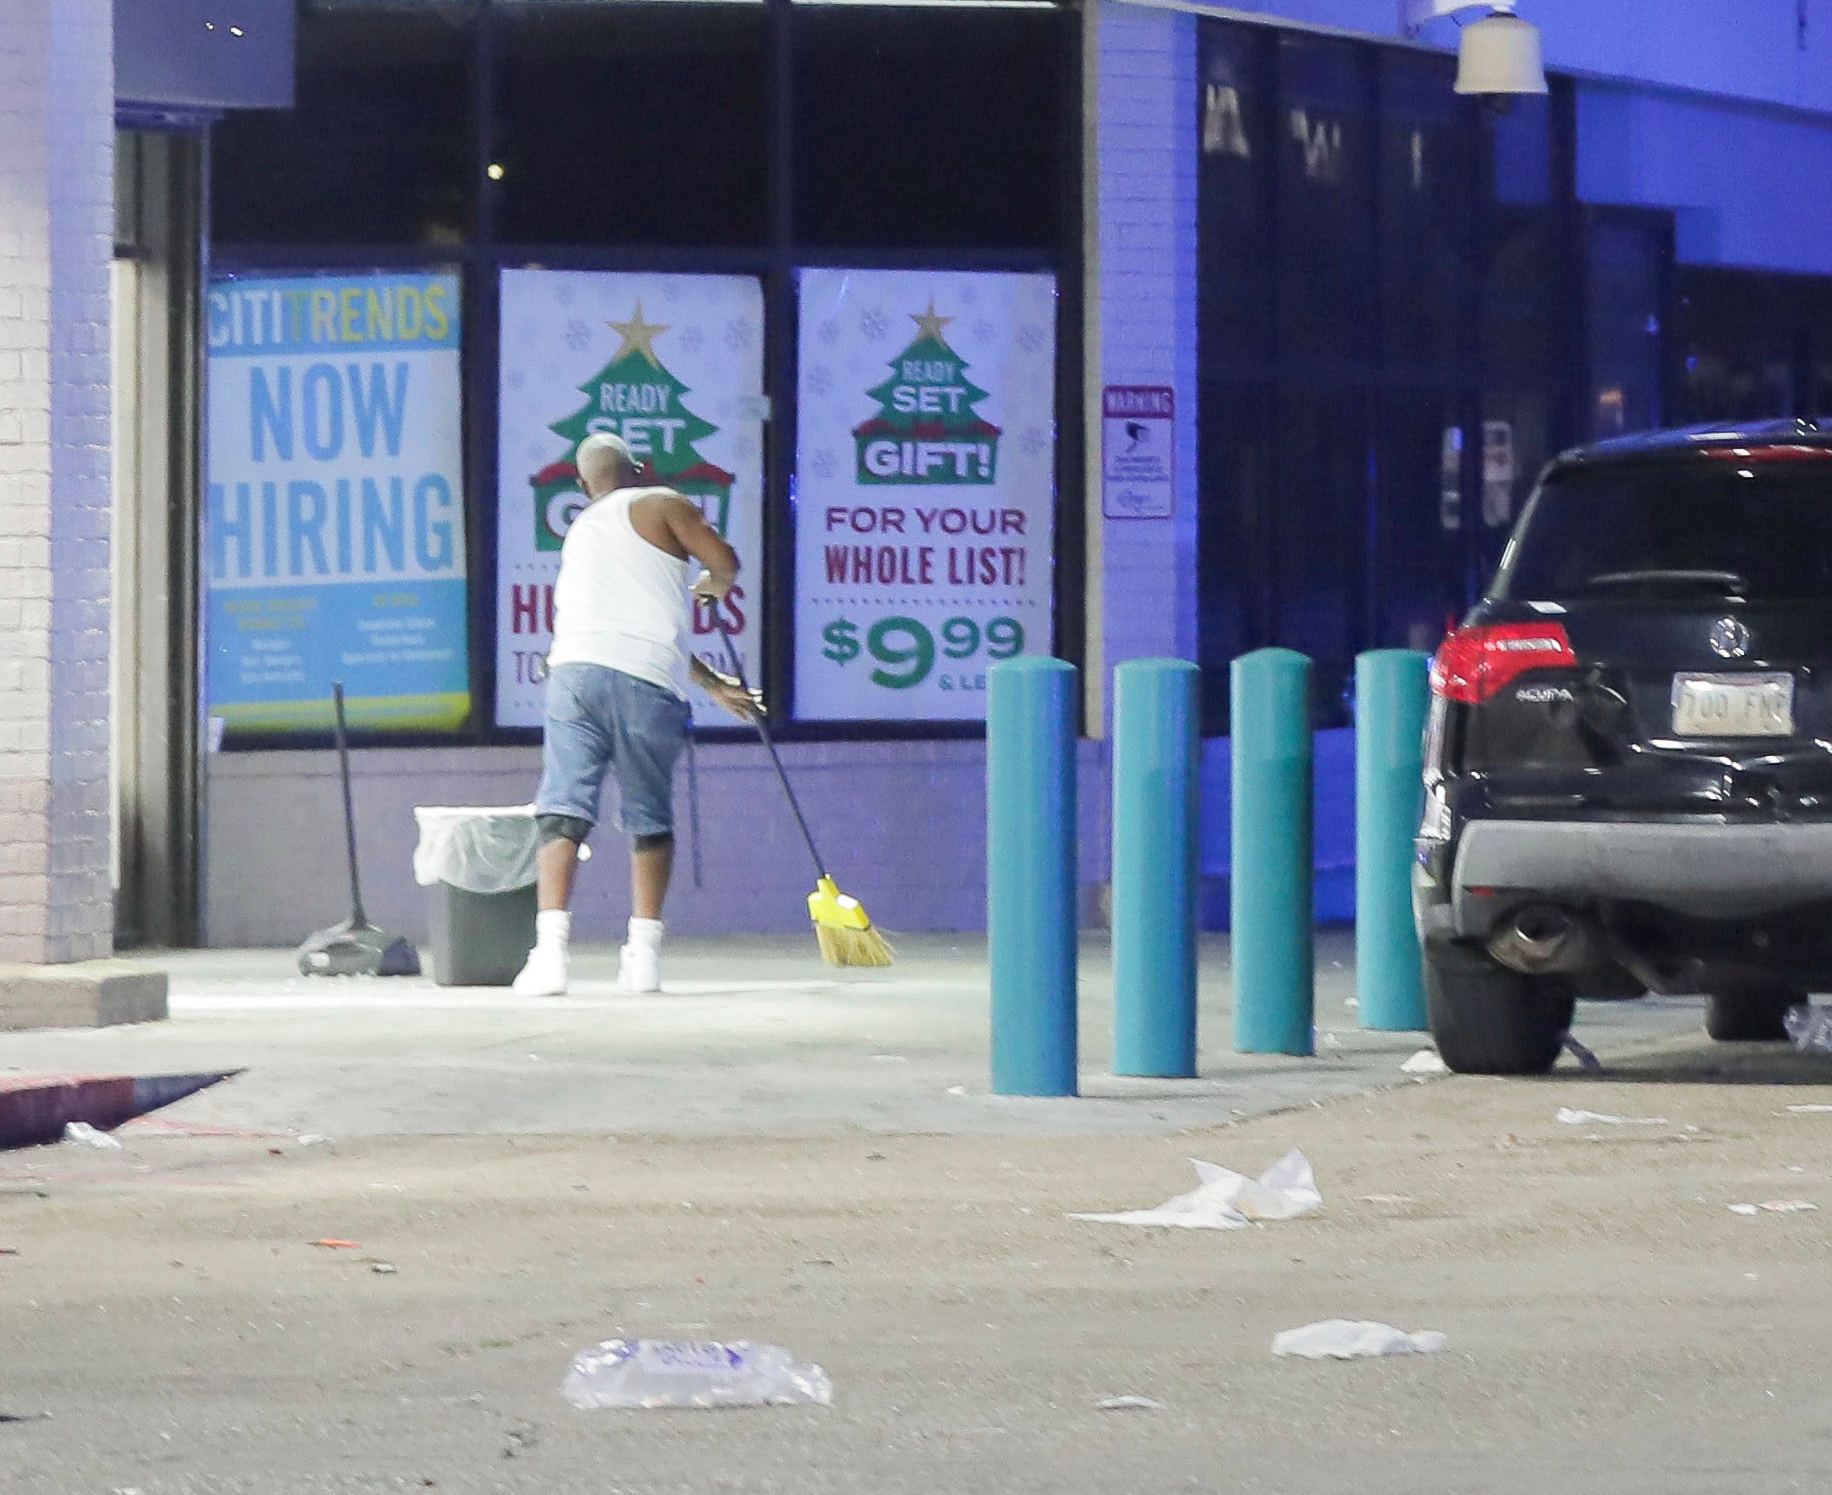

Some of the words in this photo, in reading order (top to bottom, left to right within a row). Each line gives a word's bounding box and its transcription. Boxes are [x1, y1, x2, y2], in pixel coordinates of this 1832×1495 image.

[902, 360, 957, 382] READY
[250, 362, 409, 462] NOW
[601, 383, 670, 412] READY
[892, 385, 967, 413] SET
[864, 440, 991, 478] GIFT!
[209, 473, 453, 579] HIRING
[826, 507, 906, 533] FOR
[914, 508, 1026, 535] YOUR
[824, 545, 934, 585] WHOLE
[948, 546, 1026, 586] LIST!
